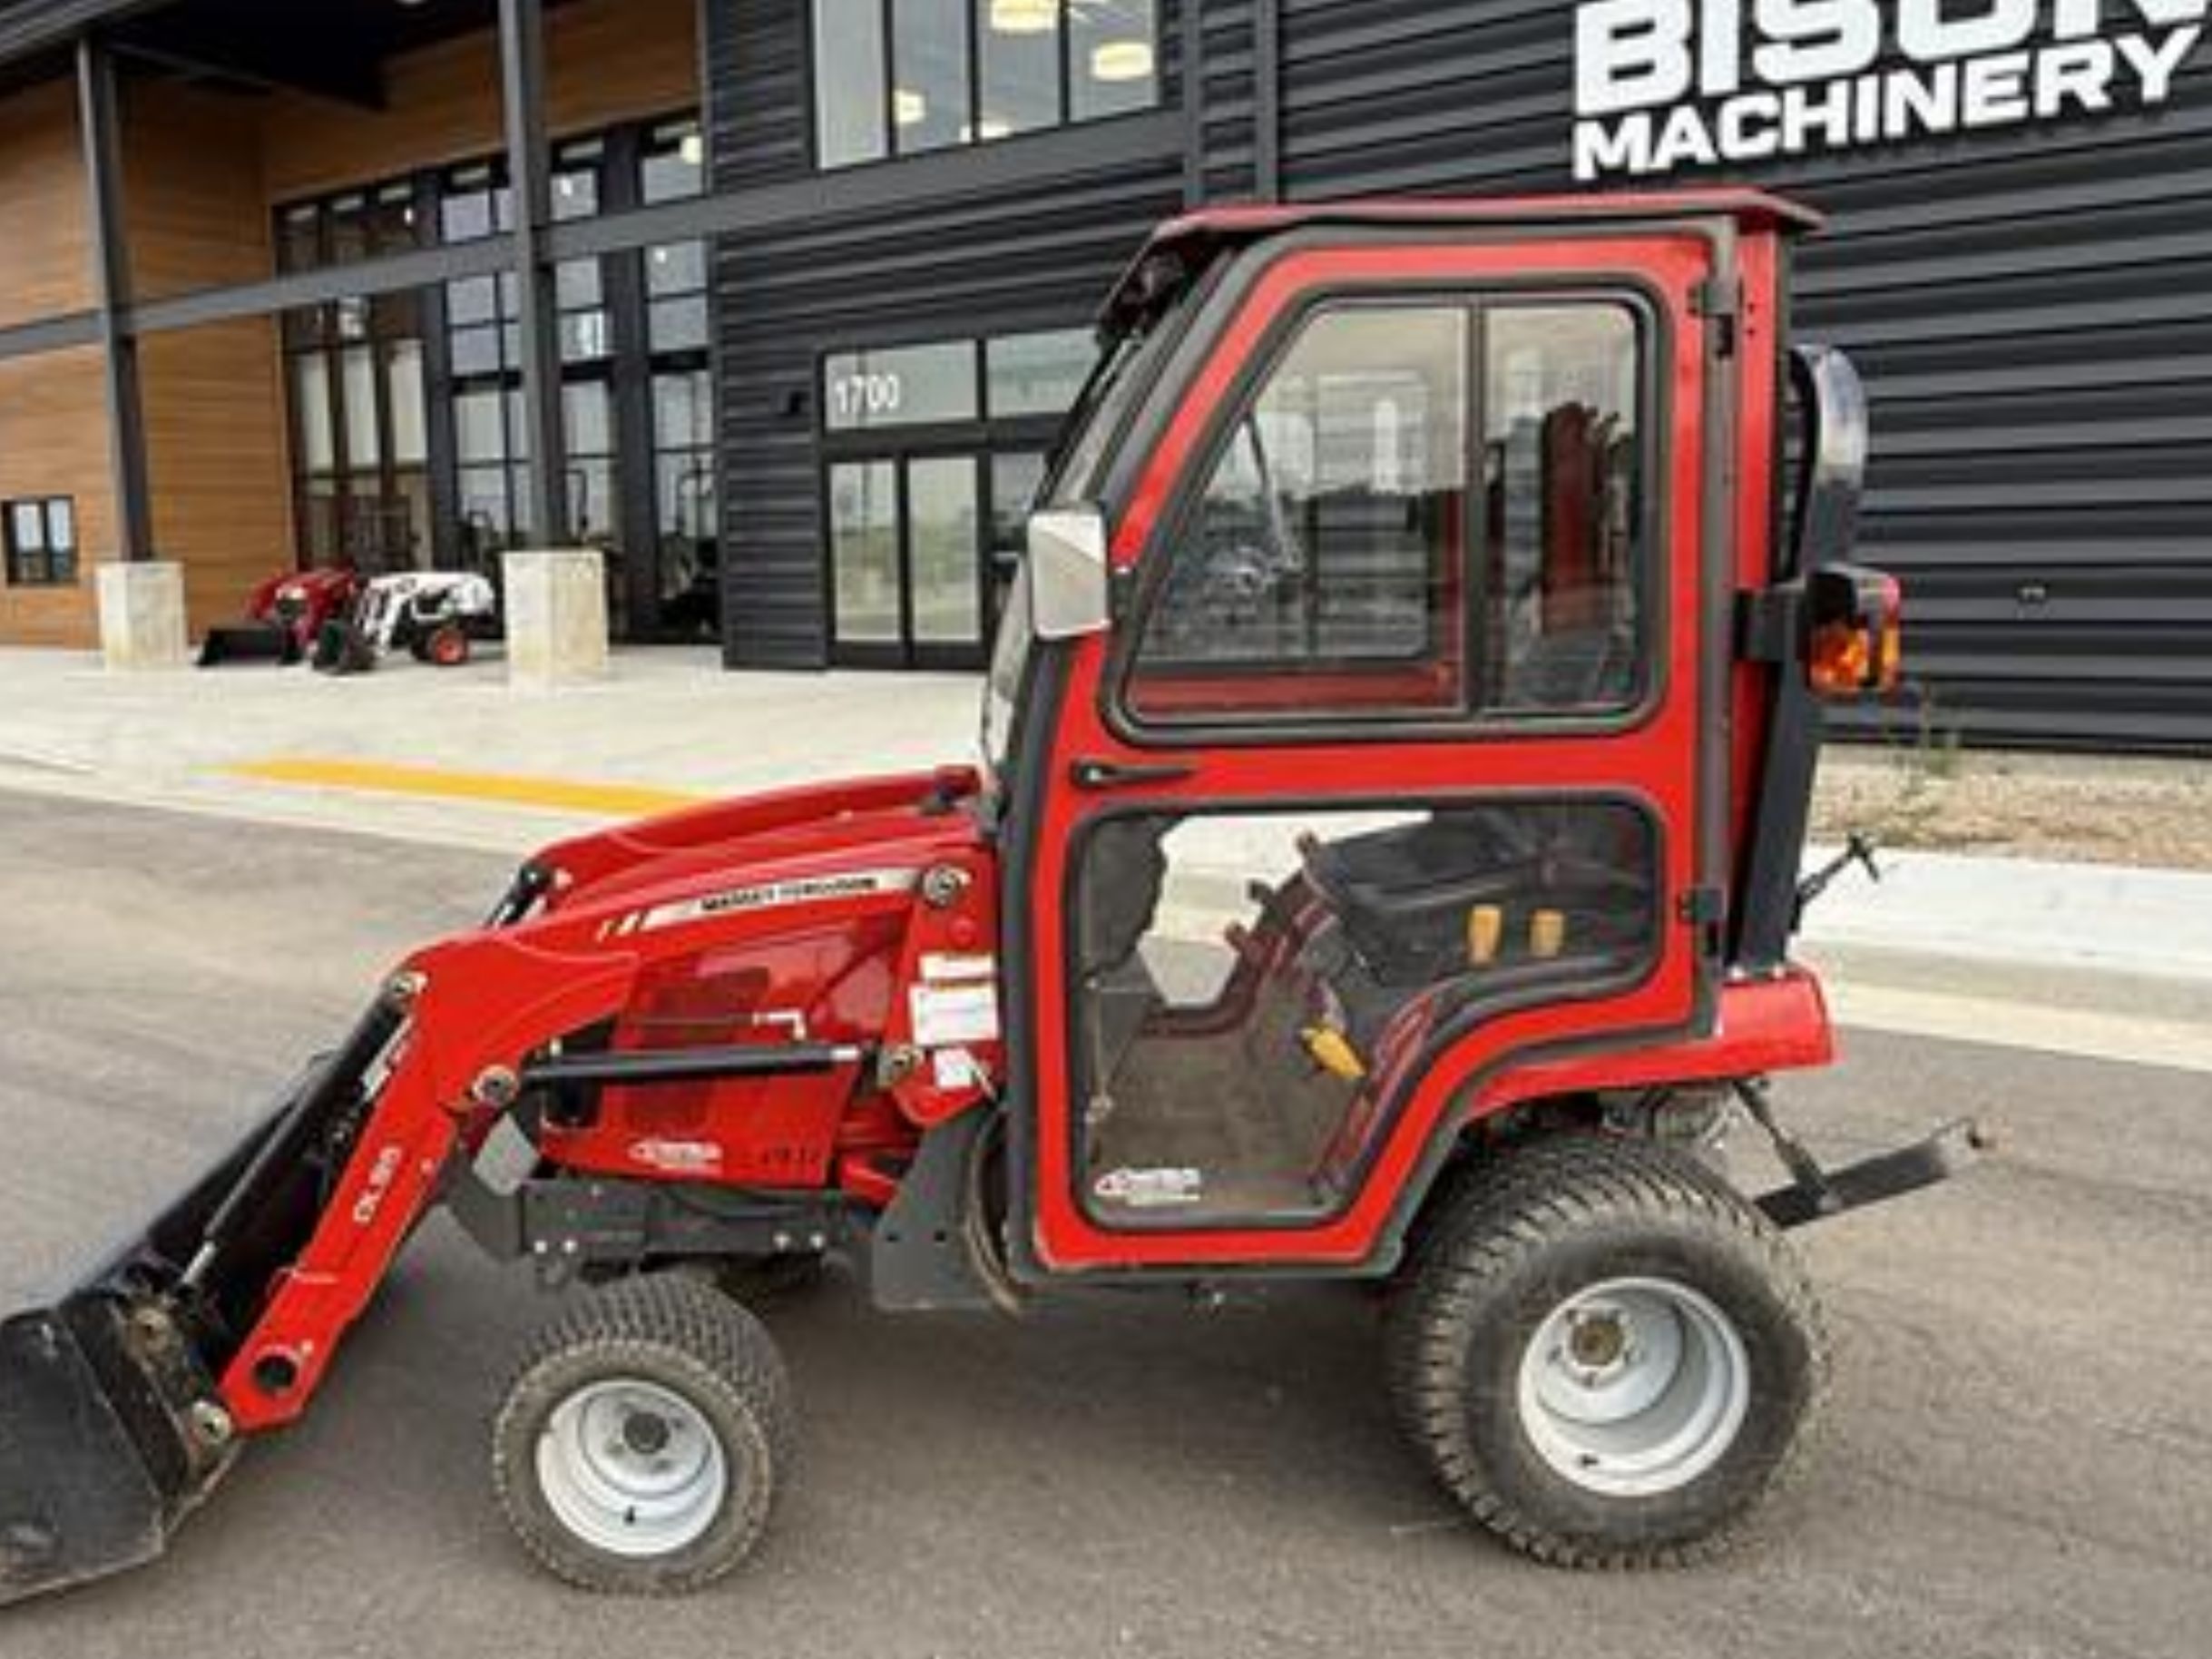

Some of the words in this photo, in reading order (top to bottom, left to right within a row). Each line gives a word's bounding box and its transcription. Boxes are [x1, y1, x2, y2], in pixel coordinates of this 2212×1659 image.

[1573, 25, 2200, 180] MACHINERY
[1574, 0, 2207, 114] BIS
[834, 374, 899, 413] 1700
